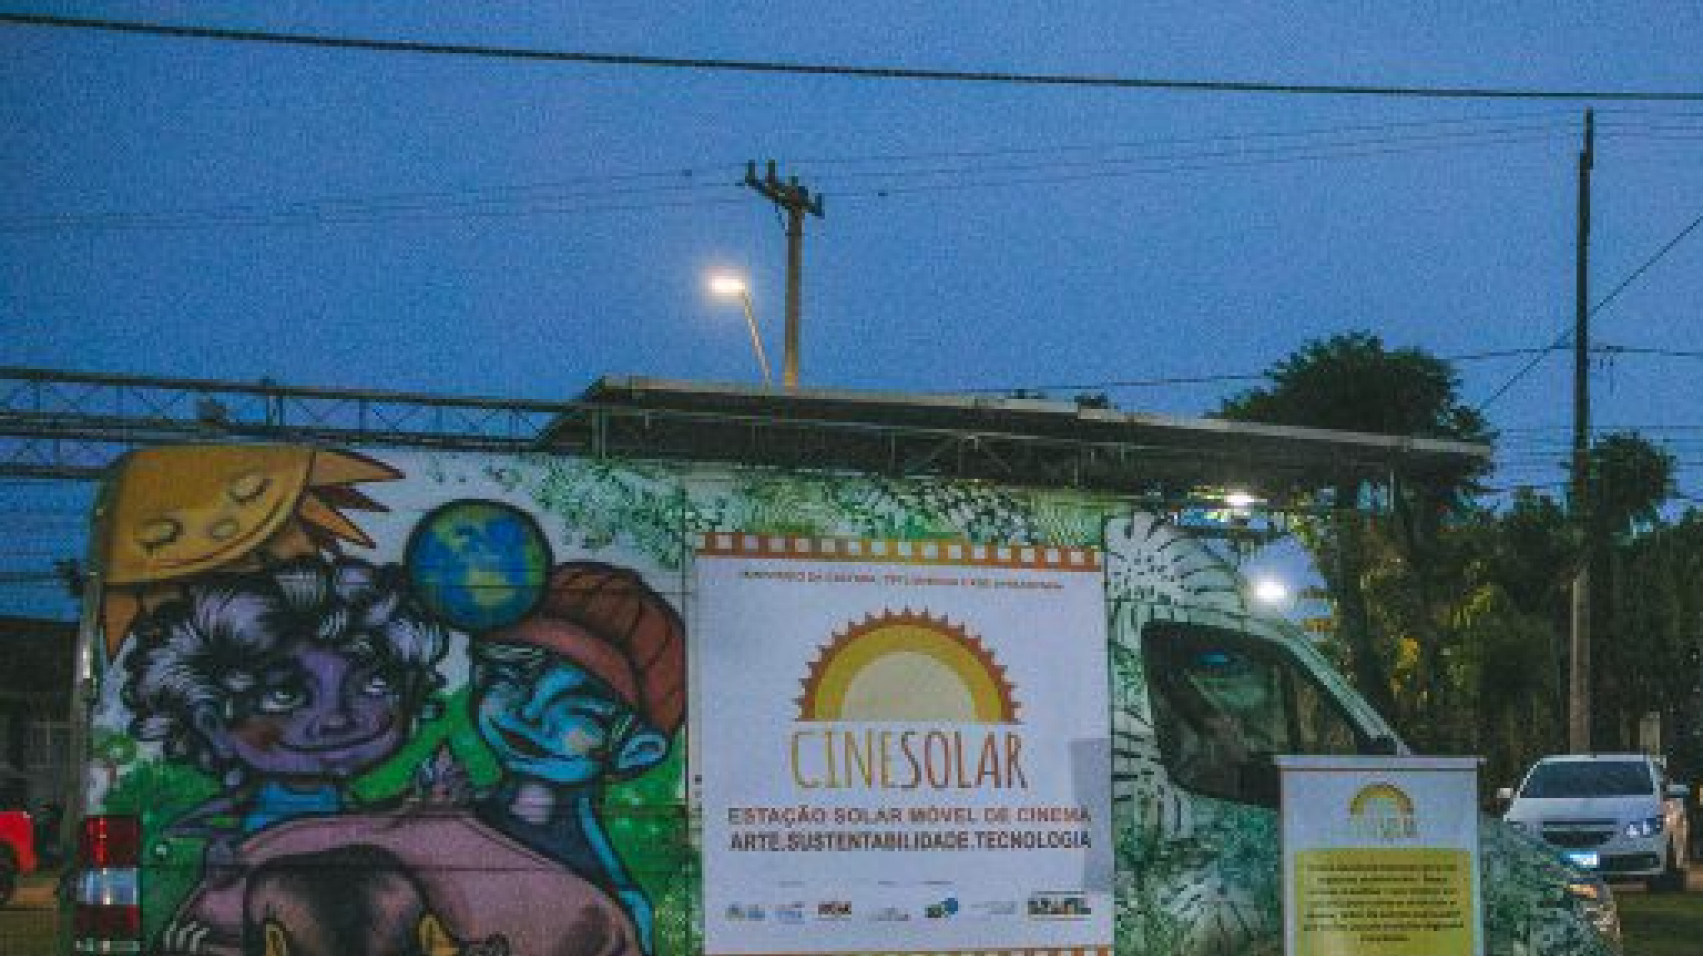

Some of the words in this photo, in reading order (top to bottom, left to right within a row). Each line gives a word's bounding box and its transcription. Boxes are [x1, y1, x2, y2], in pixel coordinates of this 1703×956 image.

[791, 731, 1029, 789] CINESOLAR
[727, 804, 826, 829] ESTAÇÃO
[834, 806, 902, 826] SOLAR
[907, 803, 978, 825] MÓVEL
[983, 807, 1010, 825] DE
[1017, 805, 1092, 823] CINEMA
